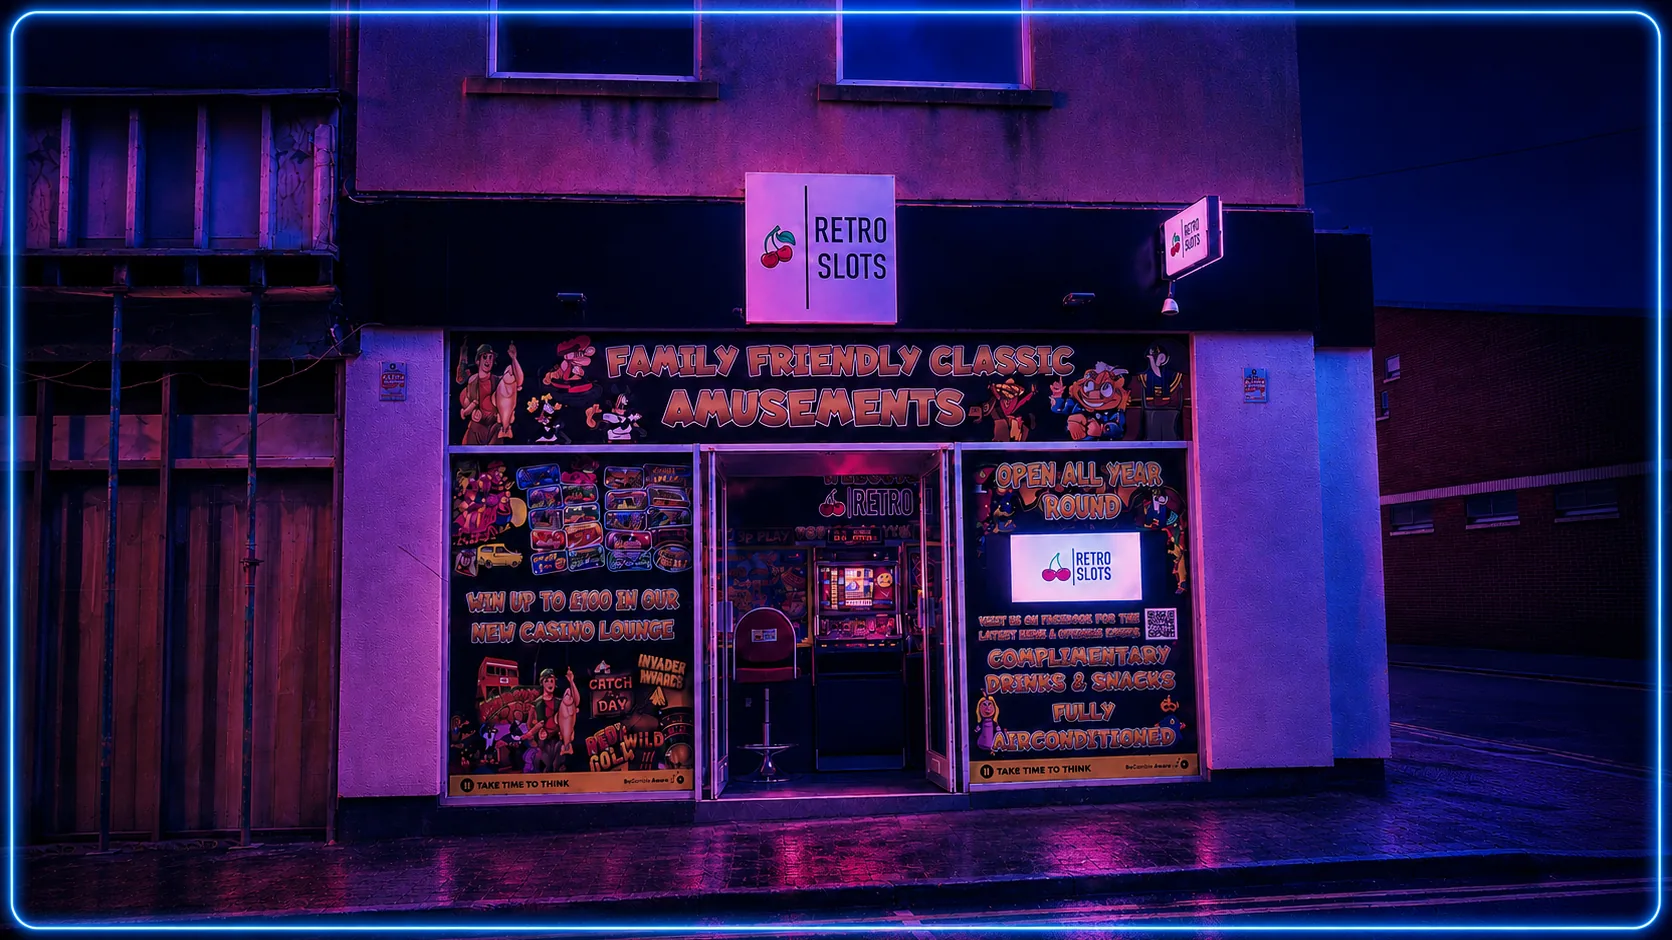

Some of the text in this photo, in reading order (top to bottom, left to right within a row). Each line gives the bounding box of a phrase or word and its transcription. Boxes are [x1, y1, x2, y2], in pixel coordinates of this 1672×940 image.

[815, 217, 887, 243] RETRO
[1184, 217, 1200, 237] RETRO
[1184, 233, 1201, 251] SLOTS
[818, 253, 887, 279] SLOTS
[605, 344, 1076, 379] FAMILY FRIENDLY CLASSIC
[660, 387, 967, 429] AMUSEMENTS
[995, 460, 1164, 490] OPEN ALL YEAR
[853, 487, 914, 517] RETRO
[1042, 492, 1122, 521] ROUND
[1076, 551, 1111, 566] RETRO
[1076, 566, 1112, 581] SLOTS
[466, 587, 681, 614] WIN UP TO £100 IN OUR
[470, 618, 676, 644] NEW CASINO LOUNGE
[1023, 614, 1039, 626] ON
[1040, 613, 1093, 626] FACEBOOK
[1094, 612, 1116, 625] FOR
[978, 629, 1018, 641] LATEST
[637, 653, 687, 676] INVADER
[987, 644, 1172, 670] COMPLIMENTARY
[588, 675, 633, 690] CATCH
[984, 669, 1177, 695] DRINKS & SNACKS
[597, 698, 627, 713] DAY
[1051, 700, 1116, 723] FULLY
[991, 726, 1177, 753] AIRCONDITIONED
[996, 764, 1092, 775] TAKE TIME TO THINK
[477, 779, 570, 790] TAKE TIME TO THINK
